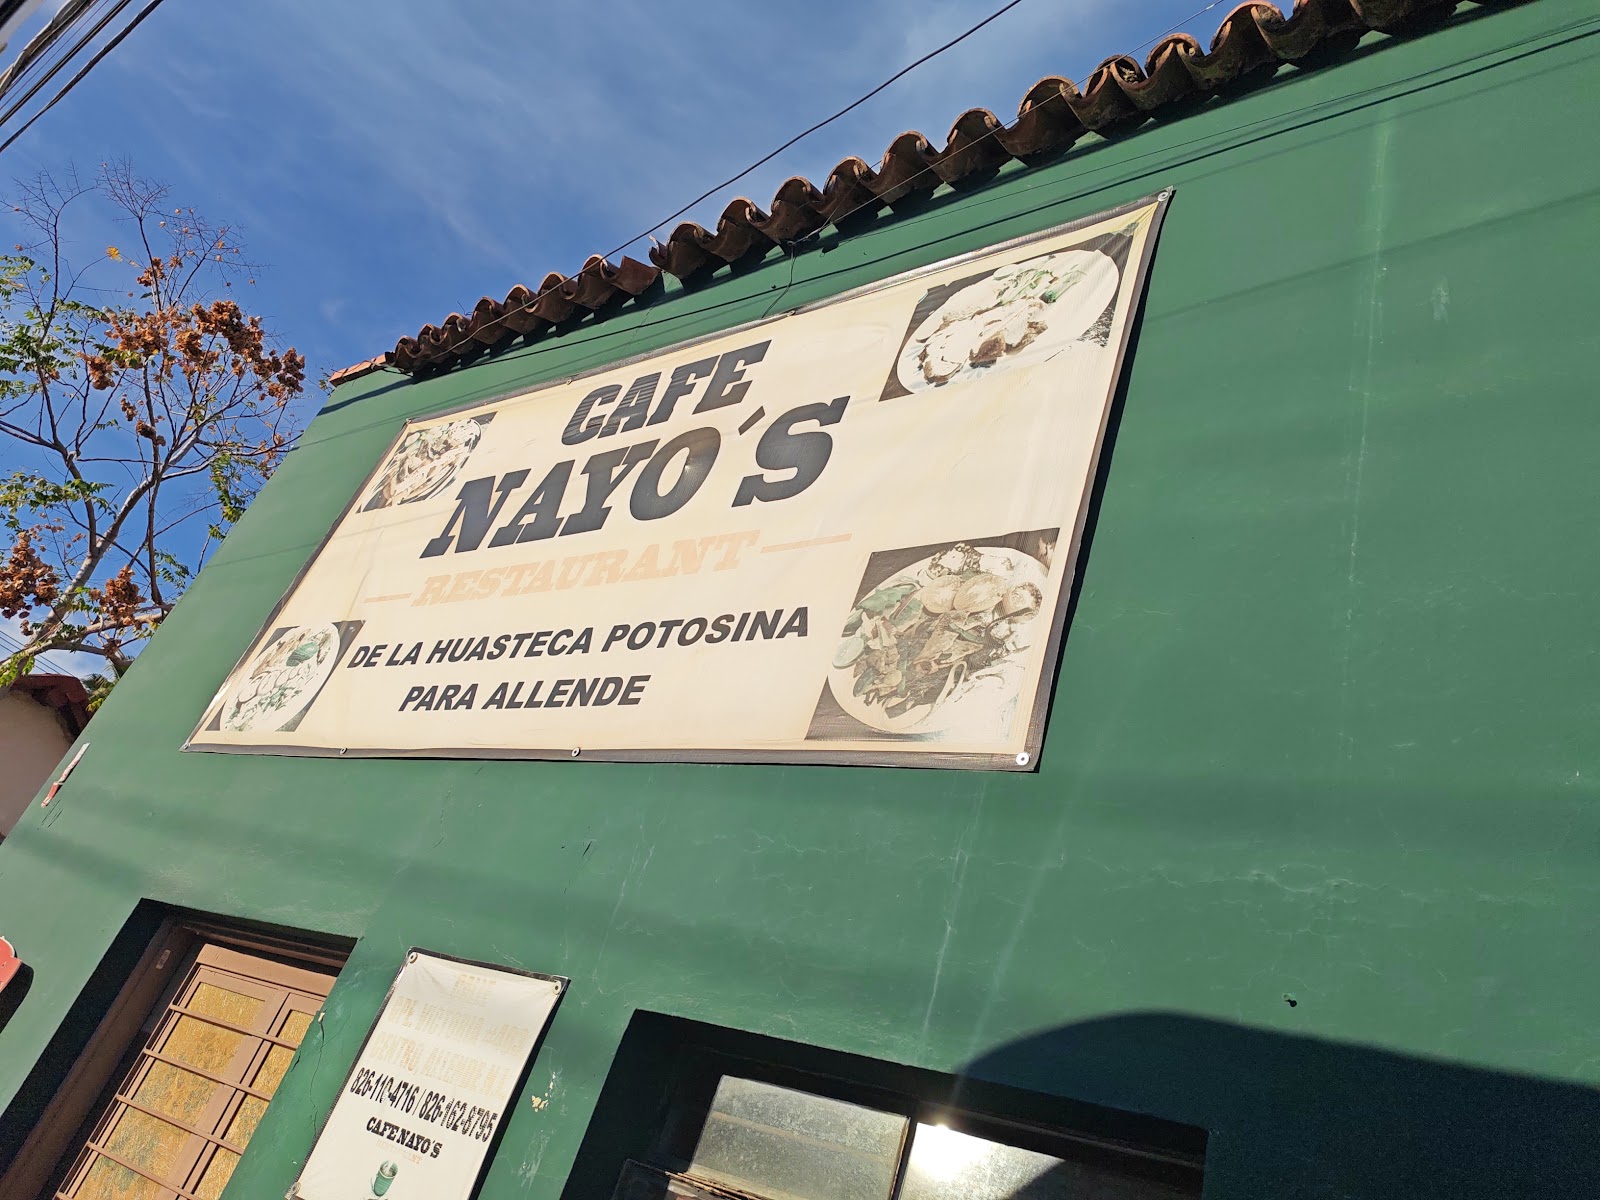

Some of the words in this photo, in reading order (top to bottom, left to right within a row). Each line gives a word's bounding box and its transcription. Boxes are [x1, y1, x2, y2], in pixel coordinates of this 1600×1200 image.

[562, 340, 771, 445] CAFE
[412, 530, 760, 607] RESTAURANT
[347, 645, 385, 669] DE
[385, 641, 423, 667] LA
[425, 627, 593, 665] HUASTECA
[601, 607, 809, 653] POTOSINA
[399, 684, 477, 712] PARA
[482, 675, 652, 710] ALLENDE
[366, 1116, 400, 1141] CAFE
